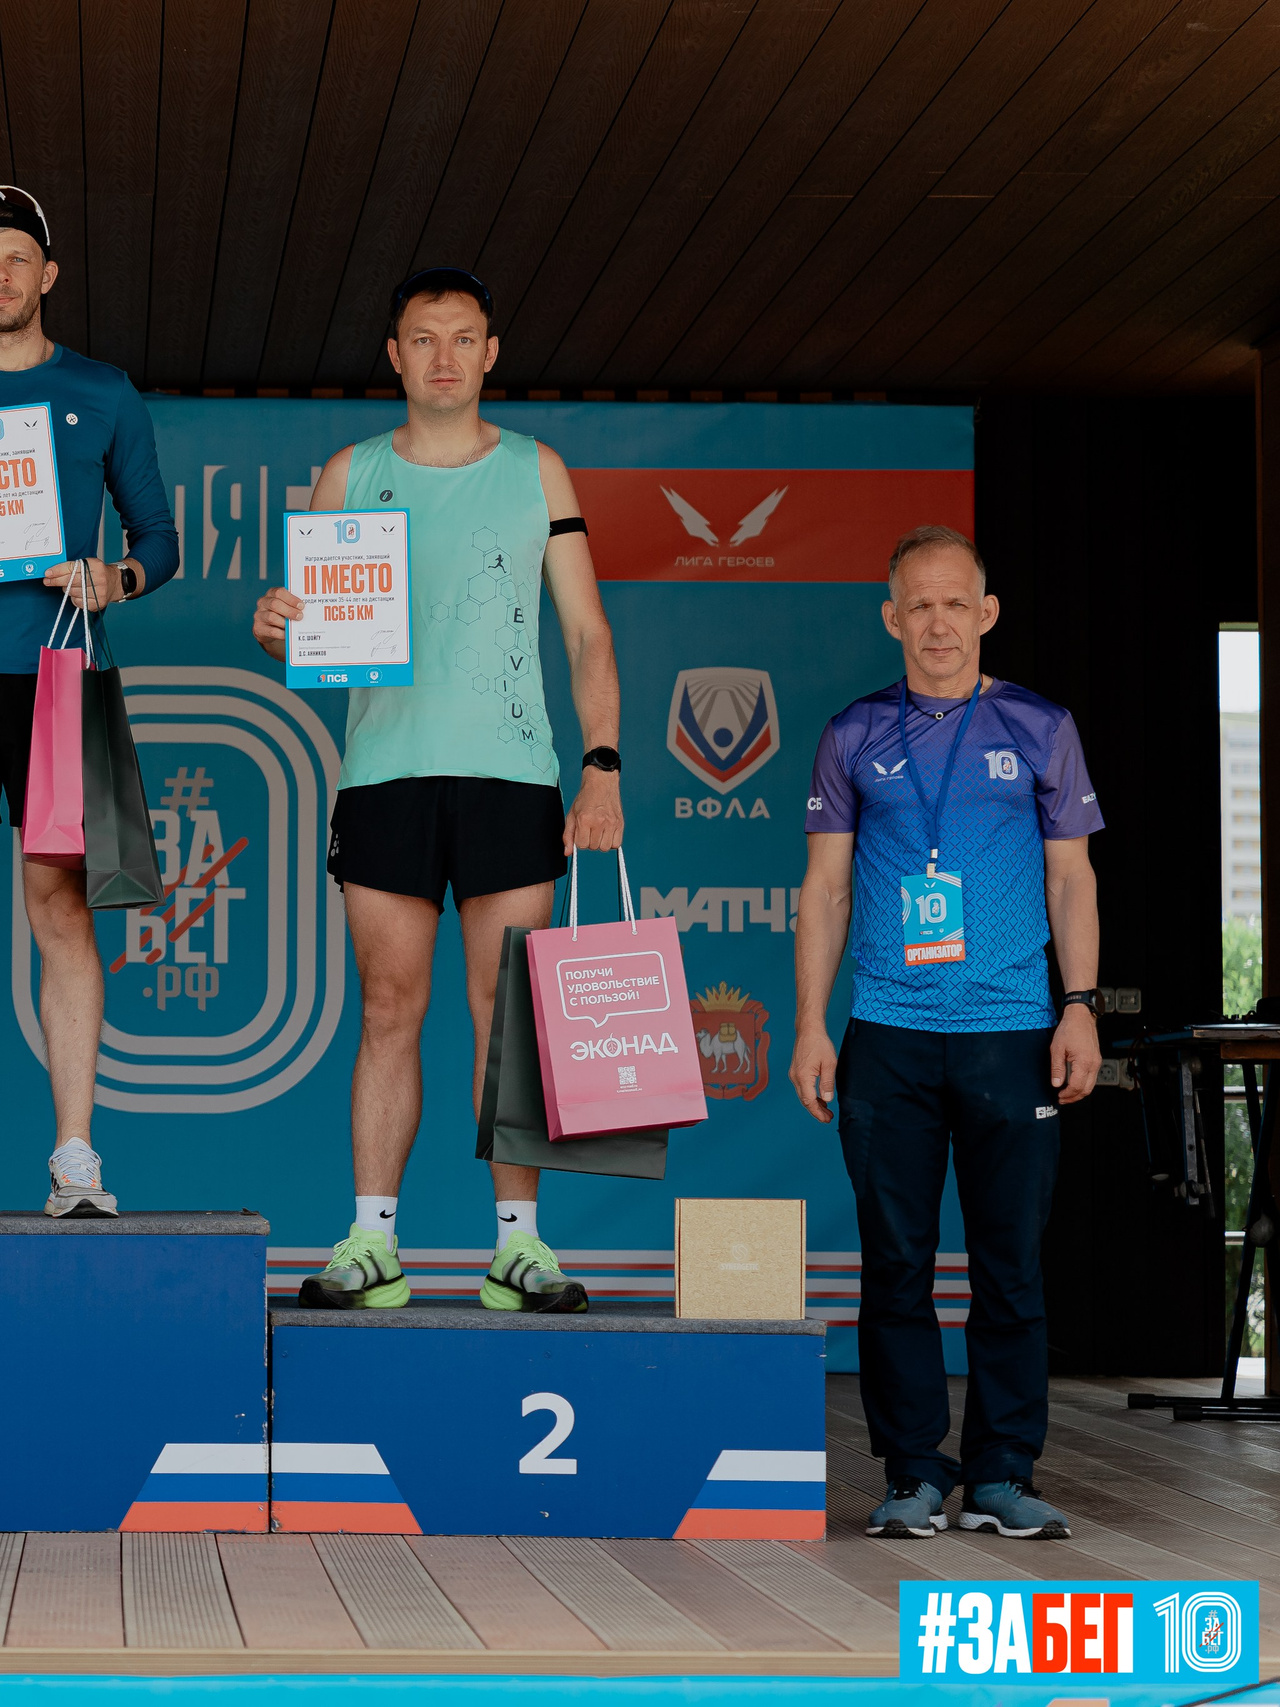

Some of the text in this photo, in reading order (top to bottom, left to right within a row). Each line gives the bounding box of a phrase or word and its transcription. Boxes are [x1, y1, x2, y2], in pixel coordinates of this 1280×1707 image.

[0, 501, 6, 516] 5
[7, 499, 24, 516] КМ
[674, 556, 775, 567] ЛИГА ГЕРОЕВ
[304, 563, 392, 594] II МЕСТО
[324, 605, 373, 621] ПСБ 5 КМ
[327, 674, 348, 682] ПСБ
[984, 750, 1018, 780] 10
[675, 797, 770, 819] ВФЛА
[915, 893, 947, 925] 10
[907, 944, 962, 961] ОРГАНИЗАТОР
[565, 968, 613, 980] ПОЛУЧИ
[567, 976, 660, 994] УДОВОЛЬСТВИЕ
[570, 991, 640, 1006] С ПОЛЬЗОЙ!
[570, 1032, 679, 1060] ЭКОНАД
[519, 1392, 577, 1475] 2
